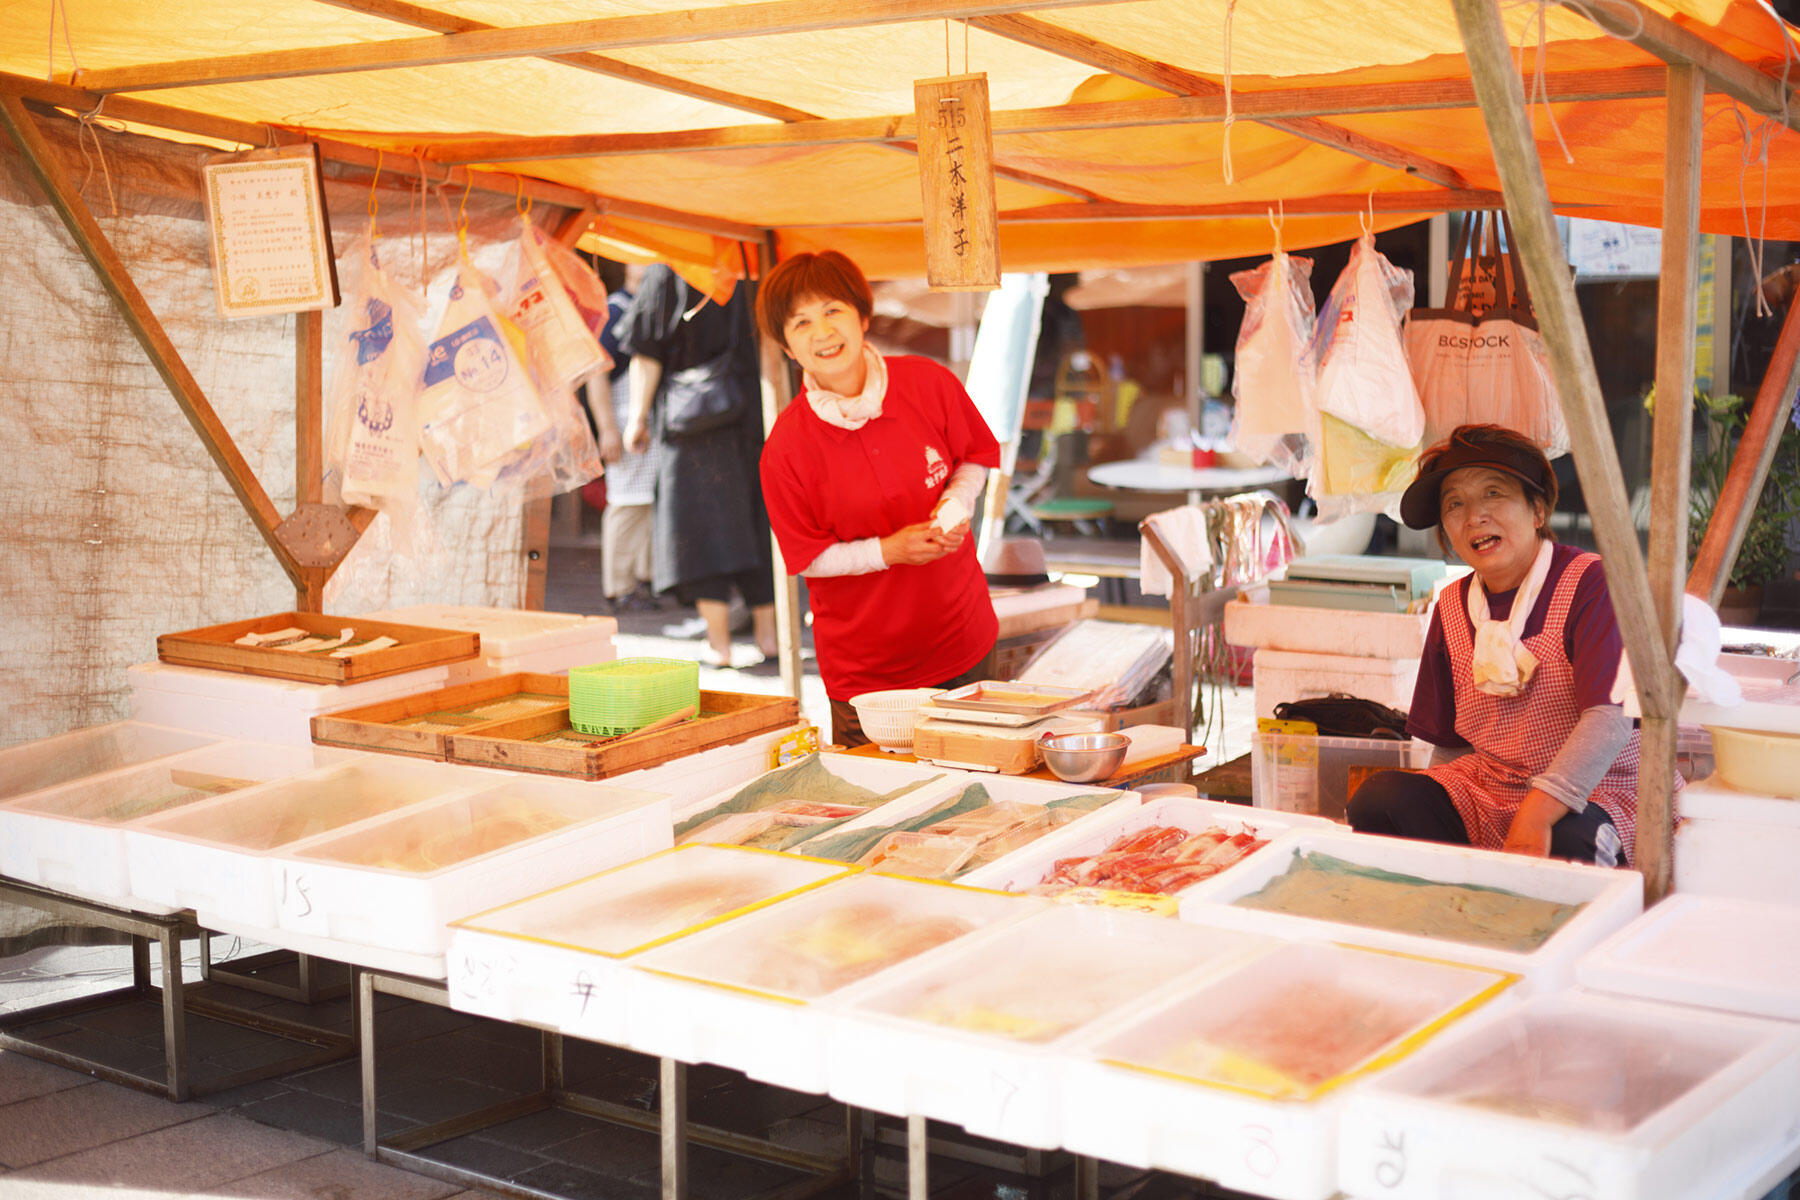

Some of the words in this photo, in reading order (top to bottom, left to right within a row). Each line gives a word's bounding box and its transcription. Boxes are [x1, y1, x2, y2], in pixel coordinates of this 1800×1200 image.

[938, 107, 966, 129] 515
[946, 137, 969, 257] 二木洋子
